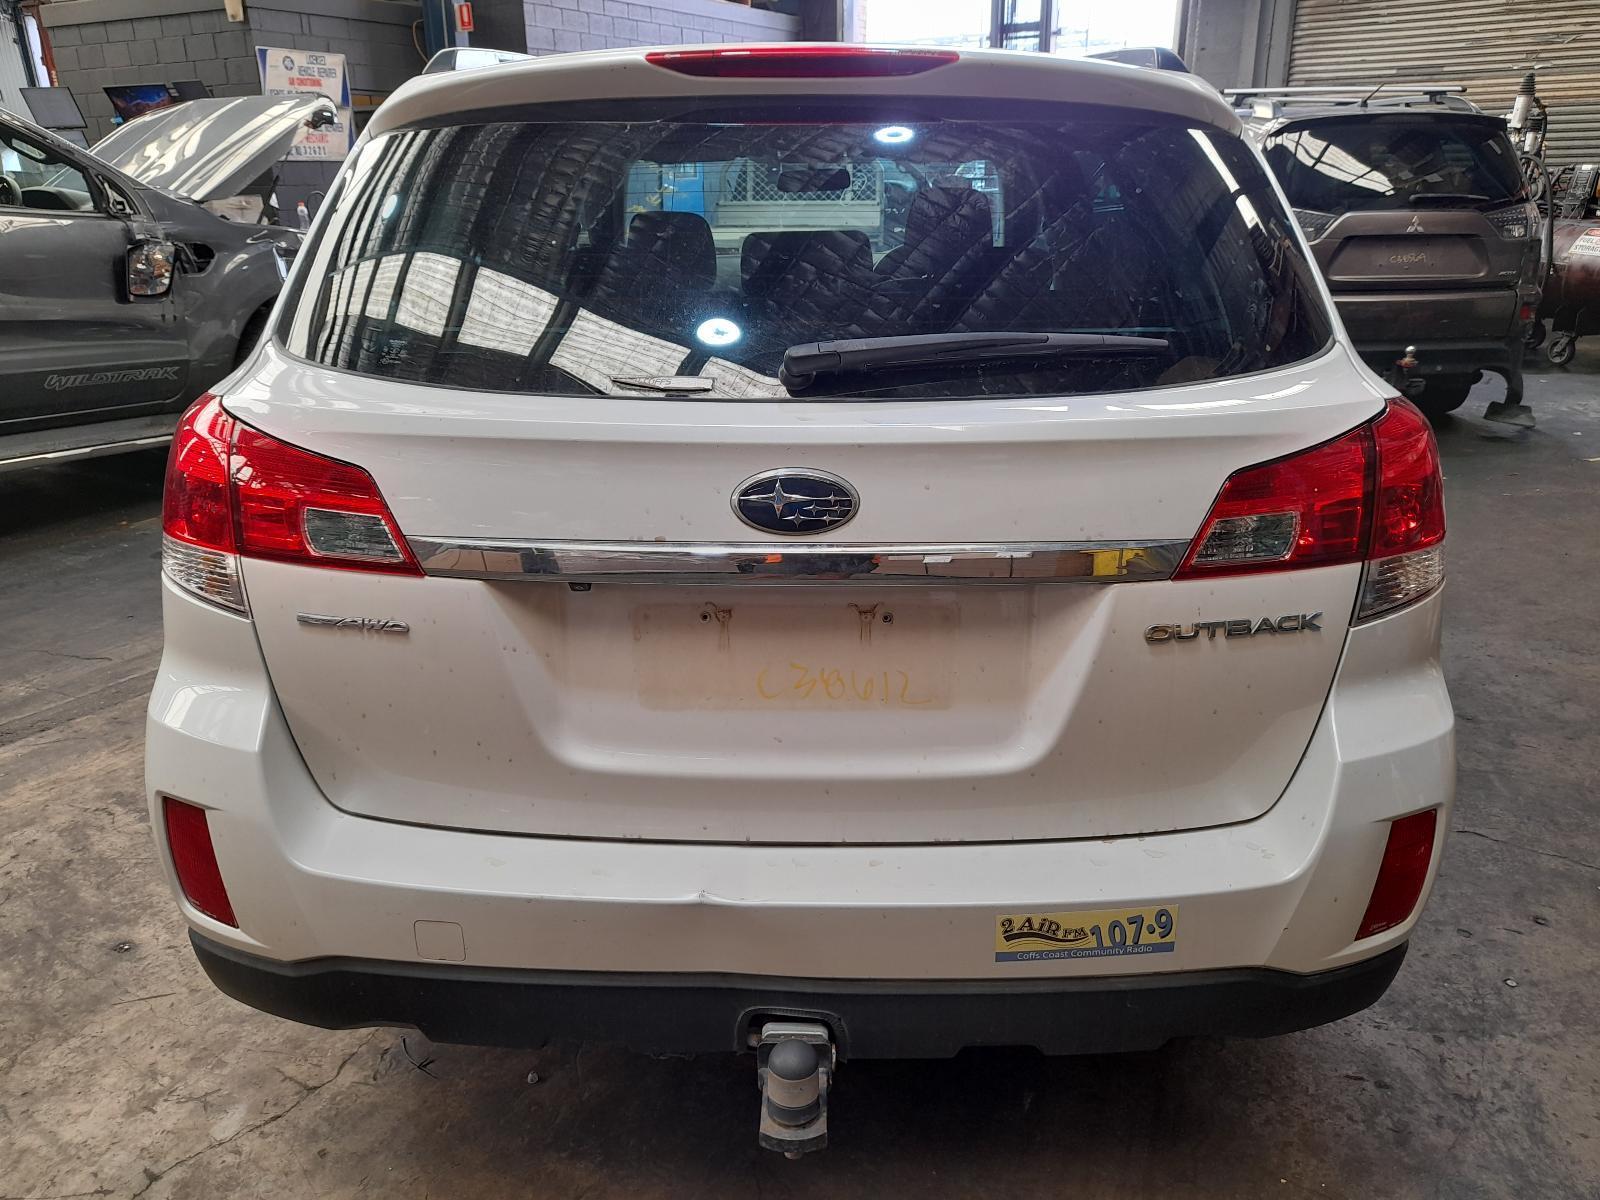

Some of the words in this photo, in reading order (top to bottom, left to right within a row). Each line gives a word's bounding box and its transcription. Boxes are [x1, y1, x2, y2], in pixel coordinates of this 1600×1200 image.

[44, 366, 180, 391] WILDTRAK
[1144, 611, 1324, 644] OUTBACK
[1017, 952, 1040, 960] Coffs
[1042, 951, 1069, 959] Coast
[1070, 947, 1125, 958] Community
[1126, 945, 1153, 954] Radio
